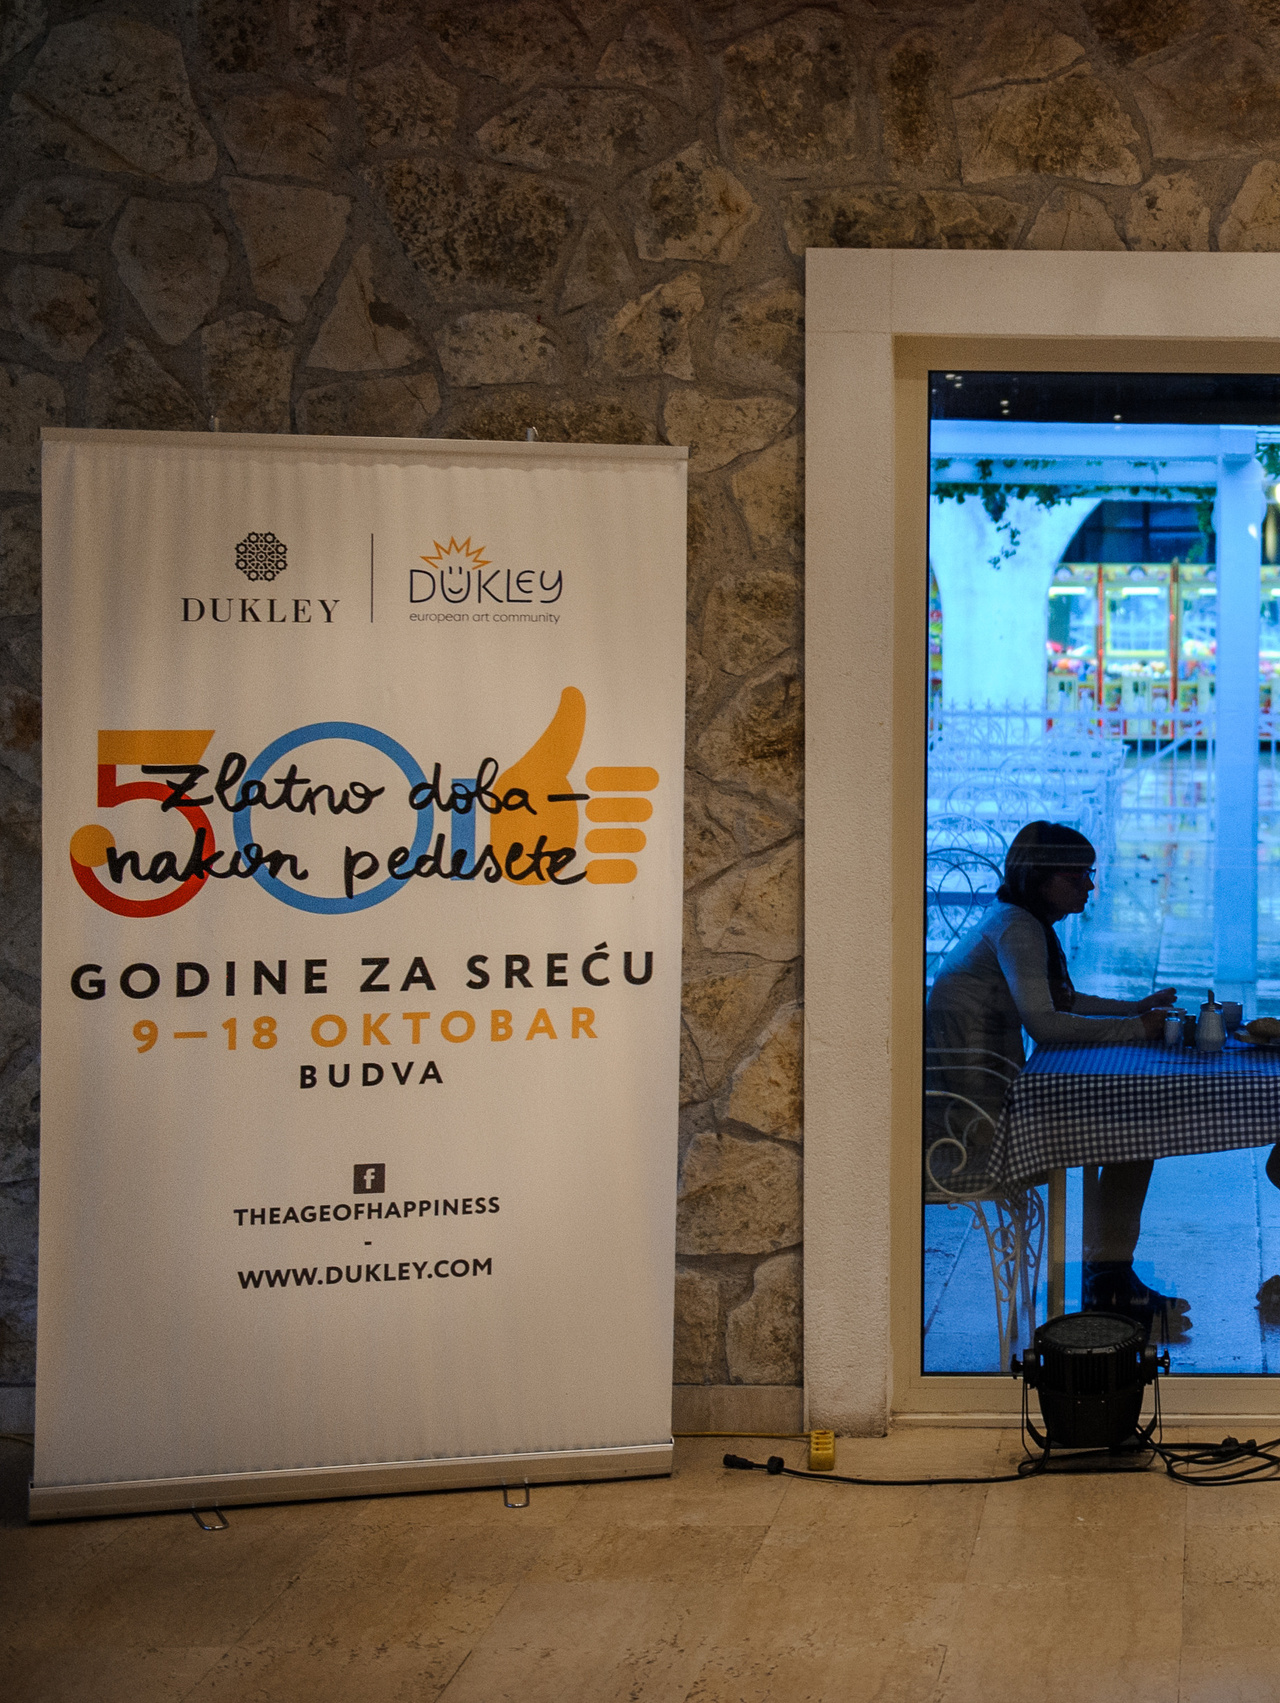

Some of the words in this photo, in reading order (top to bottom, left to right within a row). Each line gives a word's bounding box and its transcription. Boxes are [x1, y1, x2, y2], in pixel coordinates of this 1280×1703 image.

[181, 598, 341, 623] DUKLEY
[409, 612, 469, 625] european
[472, 612, 490, 622] art
[493, 612, 561, 625] community
[141, 752, 385, 816] Zlatno
[409, 758, 536, 815] doba
[107, 827, 308, 883] nakon
[345, 834, 586, 899] pedesete
[71, 959, 327, 1000] GODINE
[360, 957, 435, 992] ZA
[467, 942, 653, 989] SREĆU
[311, 1007, 596, 1047] OKTOBAR
[300, 1061, 442, 1088] BUDVA
[234, 1197, 499, 1226] THEAGEOFHAPPINESS
[238, 1258, 491, 1289] WWW.DUKLEY.COM
